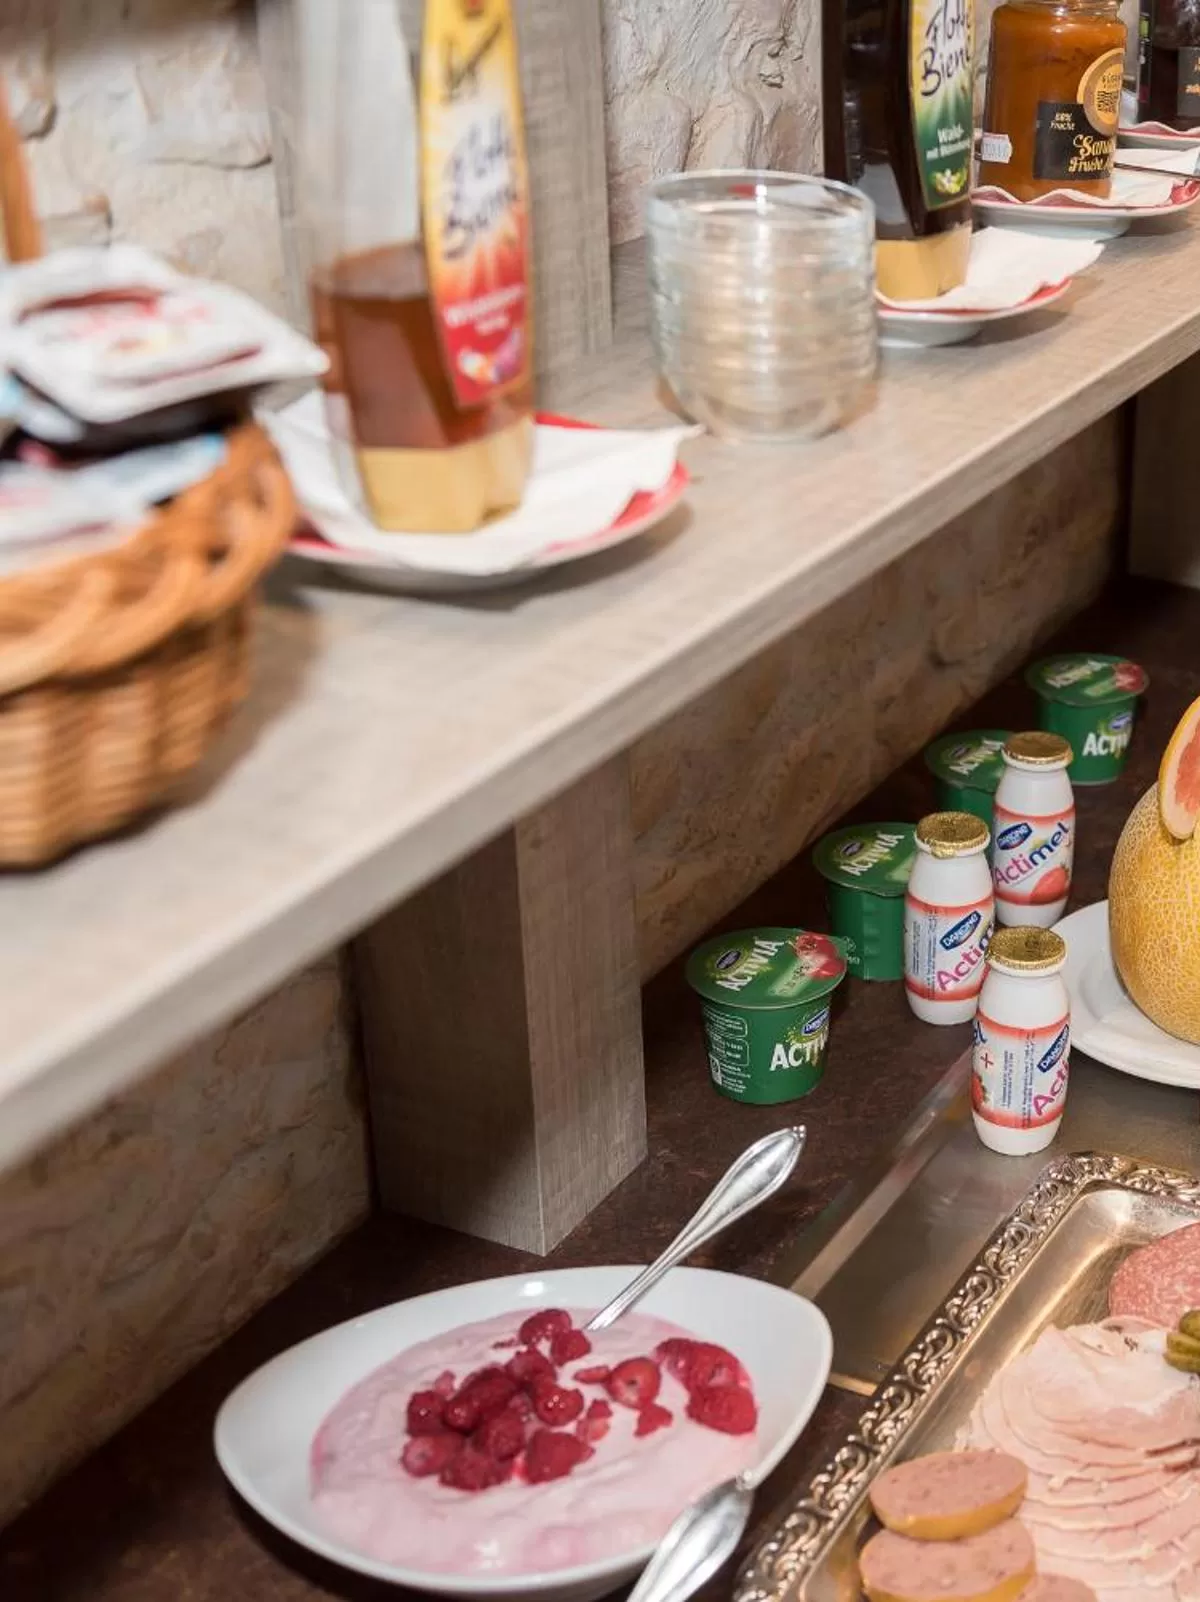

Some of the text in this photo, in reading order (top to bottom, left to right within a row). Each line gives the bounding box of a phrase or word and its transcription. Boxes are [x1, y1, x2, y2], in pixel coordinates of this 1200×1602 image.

[841, 831, 905, 876] ACTIVIA
[995, 822, 1069, 886] Actimel
[715, 939, 785, 991] ACTIVIA
